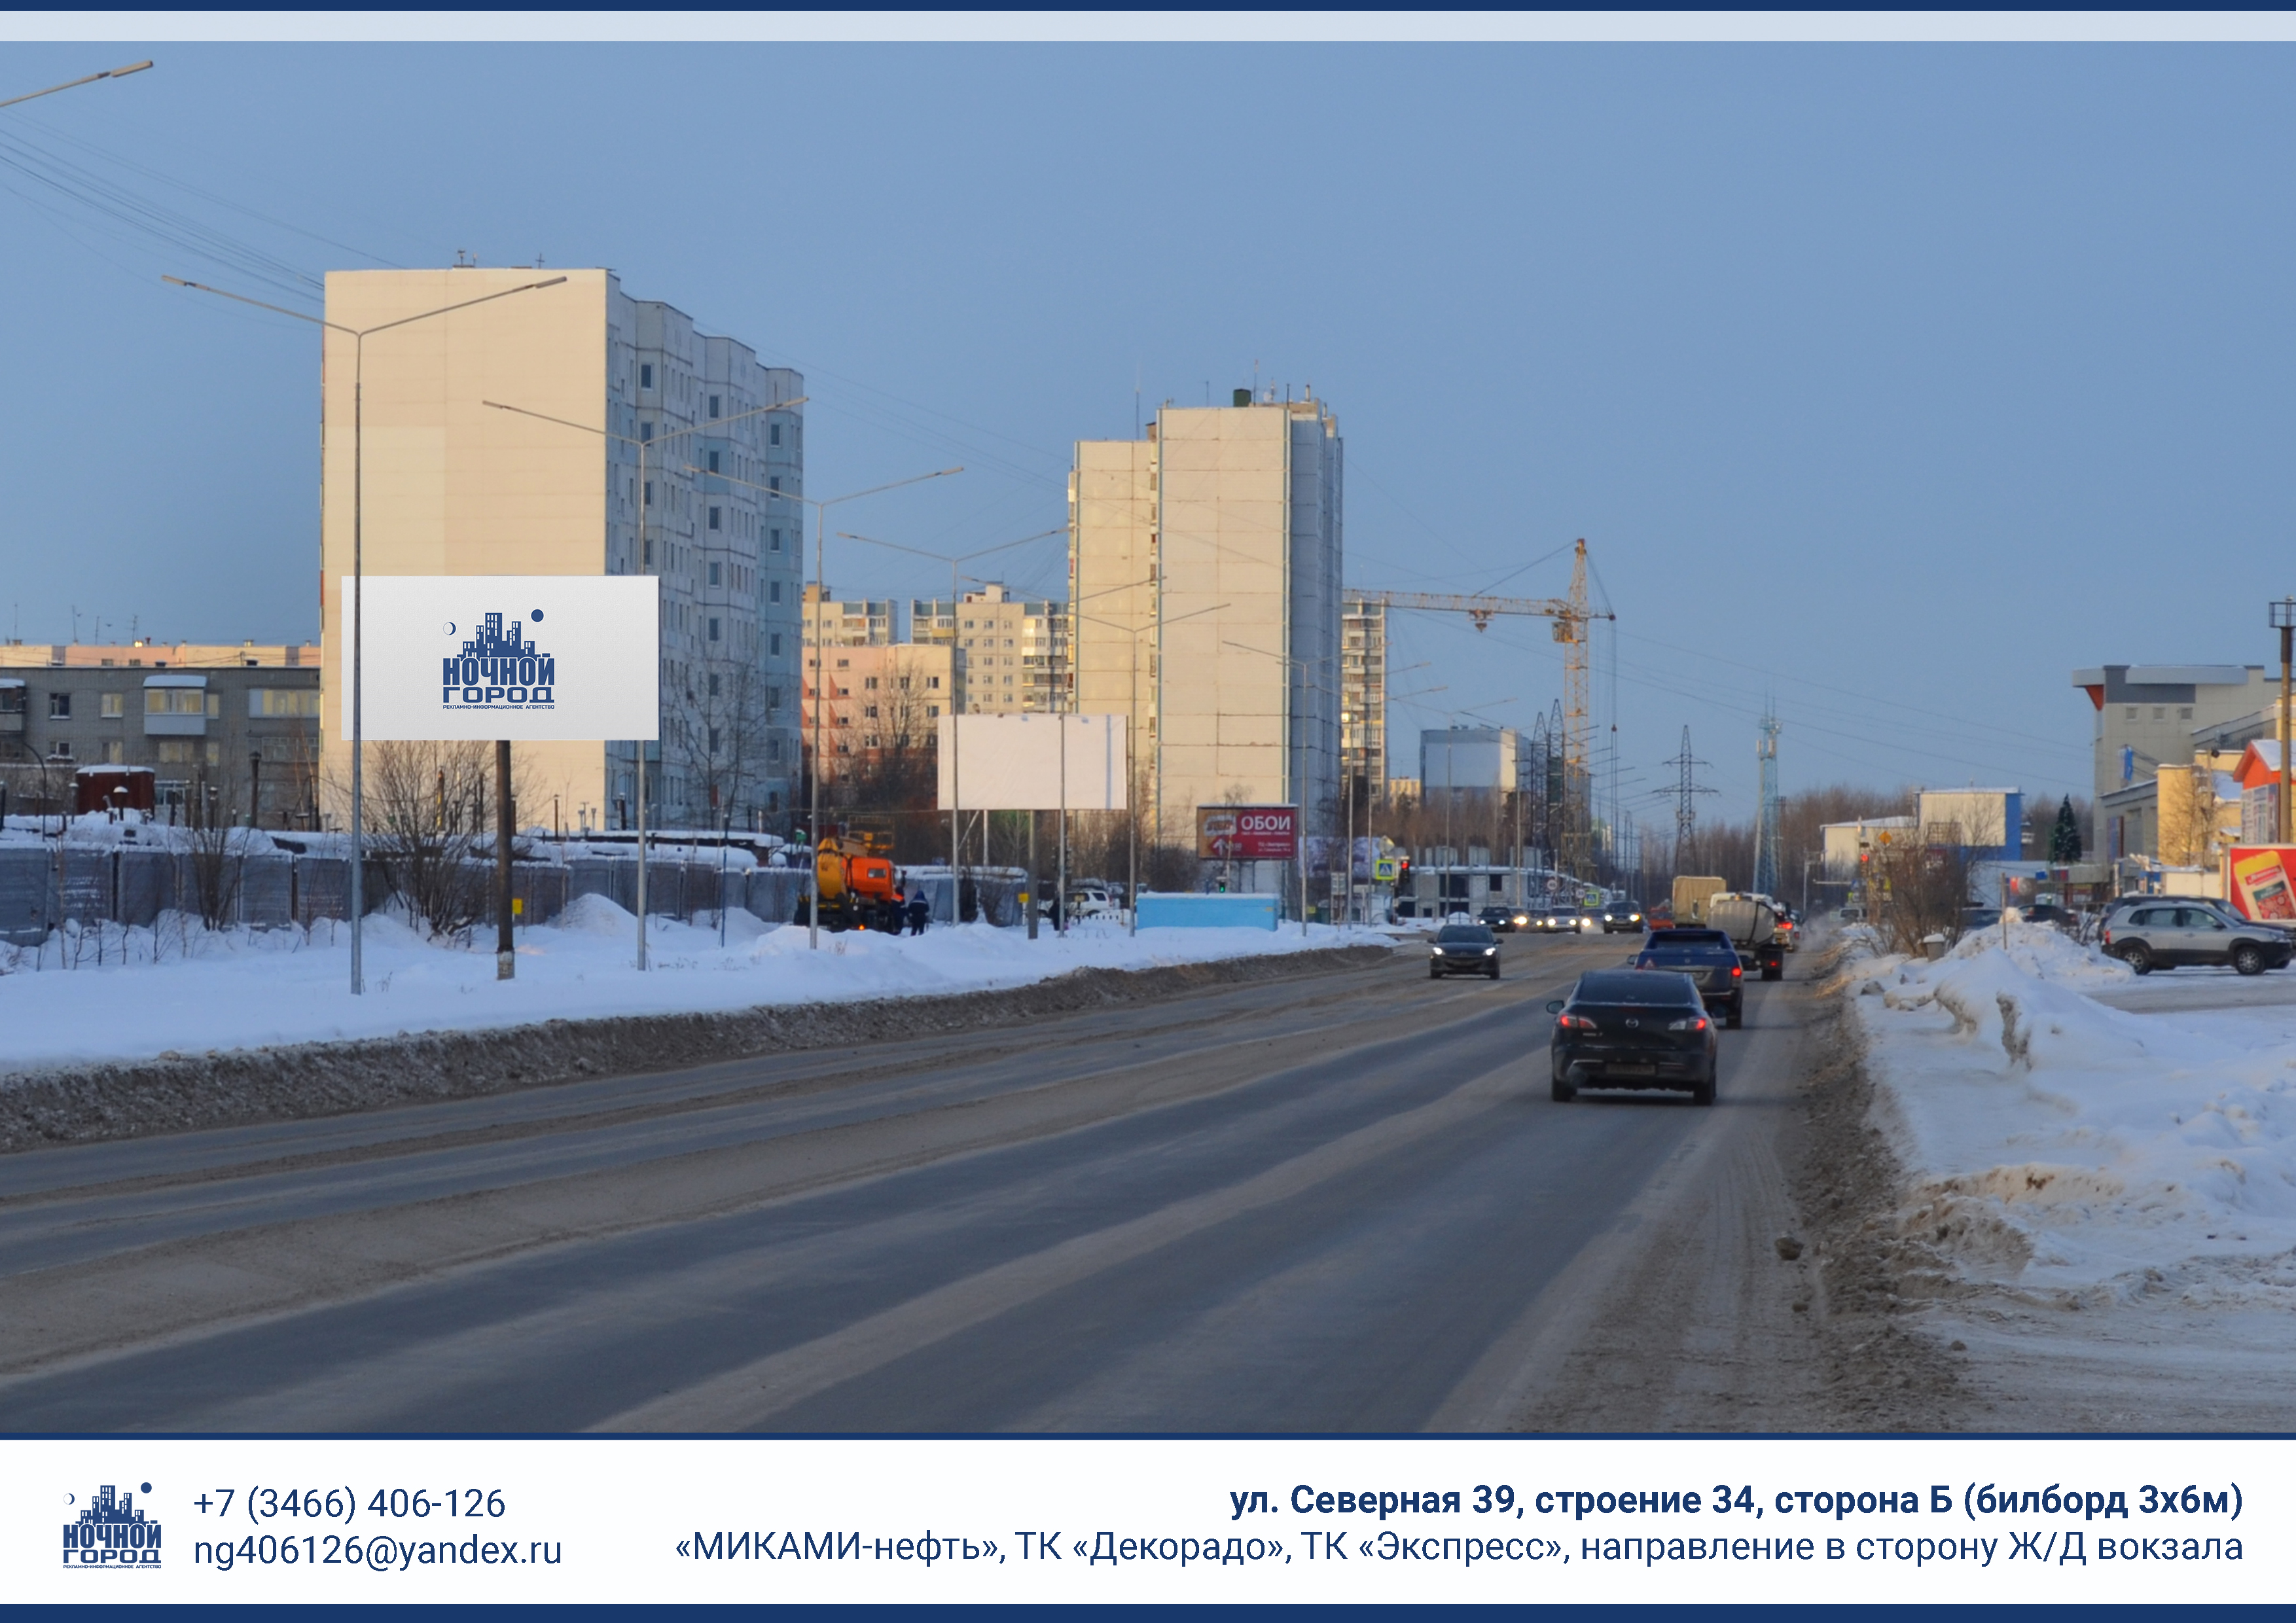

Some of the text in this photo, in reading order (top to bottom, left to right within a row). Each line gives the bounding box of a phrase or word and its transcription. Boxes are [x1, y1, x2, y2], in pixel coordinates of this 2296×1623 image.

[443, 653, 554, 686] НОЧНОЙ
[443, 687, 554, 703] ГОРОД
[1241, 816, 1291, 830] ОБОИ
